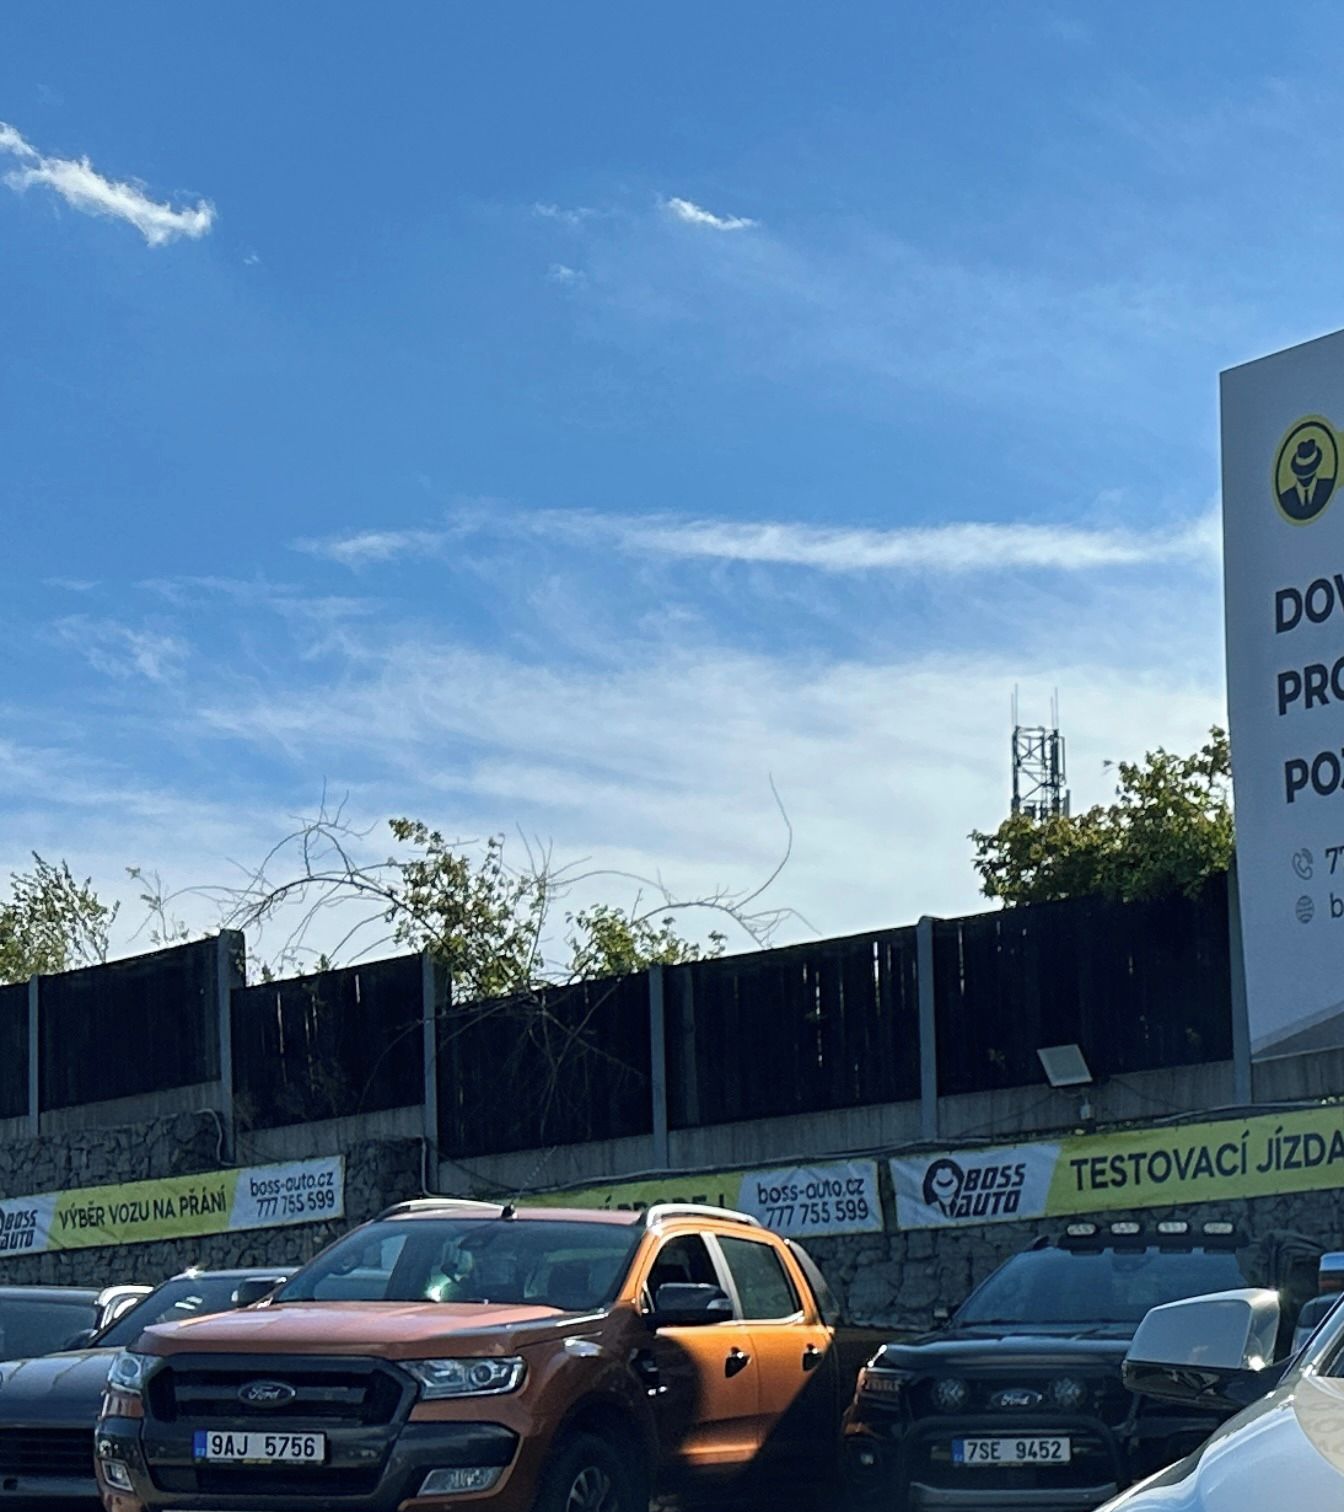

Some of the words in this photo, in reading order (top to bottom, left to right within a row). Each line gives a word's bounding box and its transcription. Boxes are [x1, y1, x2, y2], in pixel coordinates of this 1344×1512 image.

[1069, 1131, 1248, 1192] TESTOVACÍ
[250, 1172, 334, 1197] boss-auto.cz
[757, 1177, 865, 1205] boss-auto.cz
[964, 1163, 1026, 1191] BOSS
[59, 1201, 105, 1230] VÝBĚR
[109, 1202, 150, 1225] VOZU
[153, 1196, 176, 1218] NA
[180, 1184, 227, 1217] PŘÁNÍ
[257, 1197, 279, 1217] 777
[282, 1194, 305, 1213] 755
[307, 1189, 335, 1211] 599
[766, 1207, 795, 1229] 777
[800, 1203, 830, 1225] 755
[836, 1199, 869, 1222] 599
[953, 1189, 1021, 1218] AUTO
[5, 1209, 38, 1231] BOSS
[0, 1229, 35, 1250] AUTO
[212, 1434, 249, 1456] 9AJ
[265, 1436, 316, 1457] 5756
[967, 1442, 1001, 1461] 7SE
[1015, 1440, 1062, 1460] 9452
